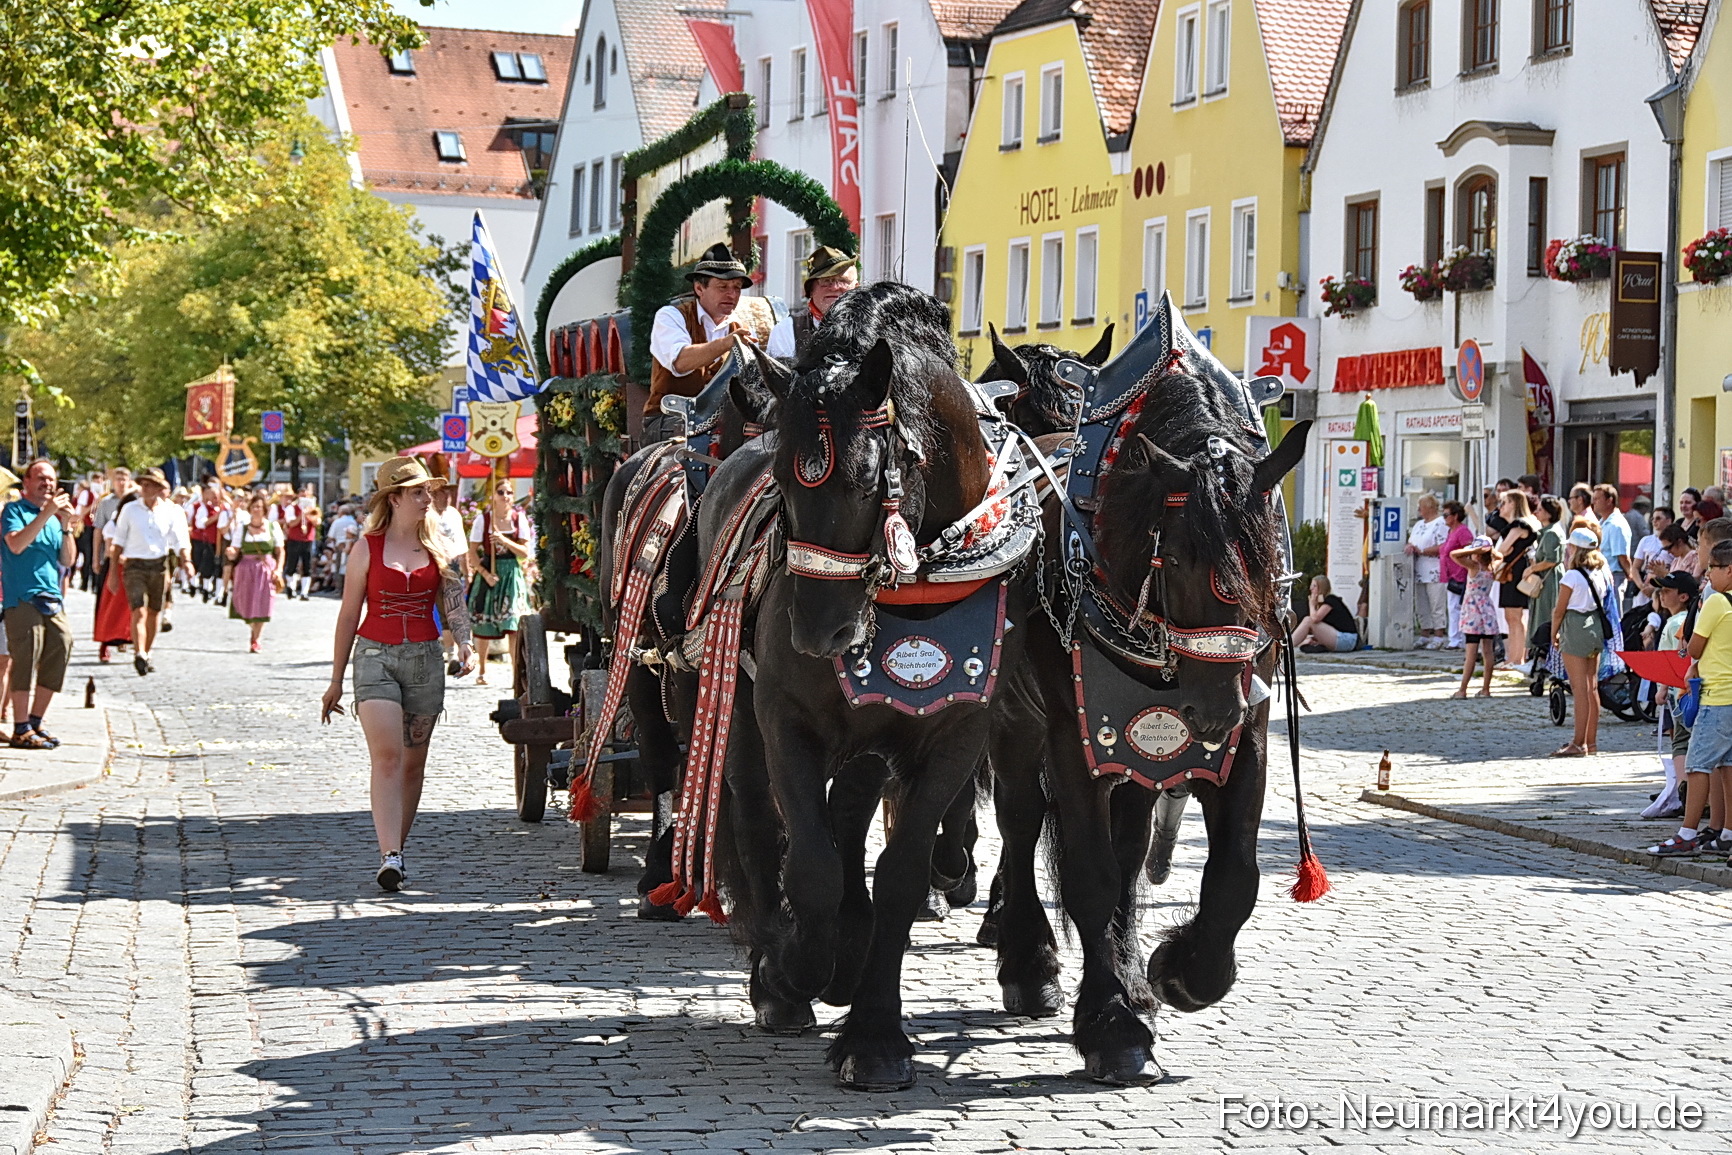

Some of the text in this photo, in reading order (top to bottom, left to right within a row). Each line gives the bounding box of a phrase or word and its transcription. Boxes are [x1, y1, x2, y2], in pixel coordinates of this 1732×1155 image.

[1020, 181, 1119, 226] HOTEL Lehmeier
[1332, 347, 1445, 392] APOTHEKE
[1327, 421, 1351, 433] RATHAUS
[1405, 415, 1432, 428] RATHAUS
[444, 440, 465, 450] TAXI
[1387, 511, 1398, 528] P
[896, 651, 918, 659] Albert
[897, 662, 937, 670] Richthofen
[1140, 734, 1179, 742] Richthofen
